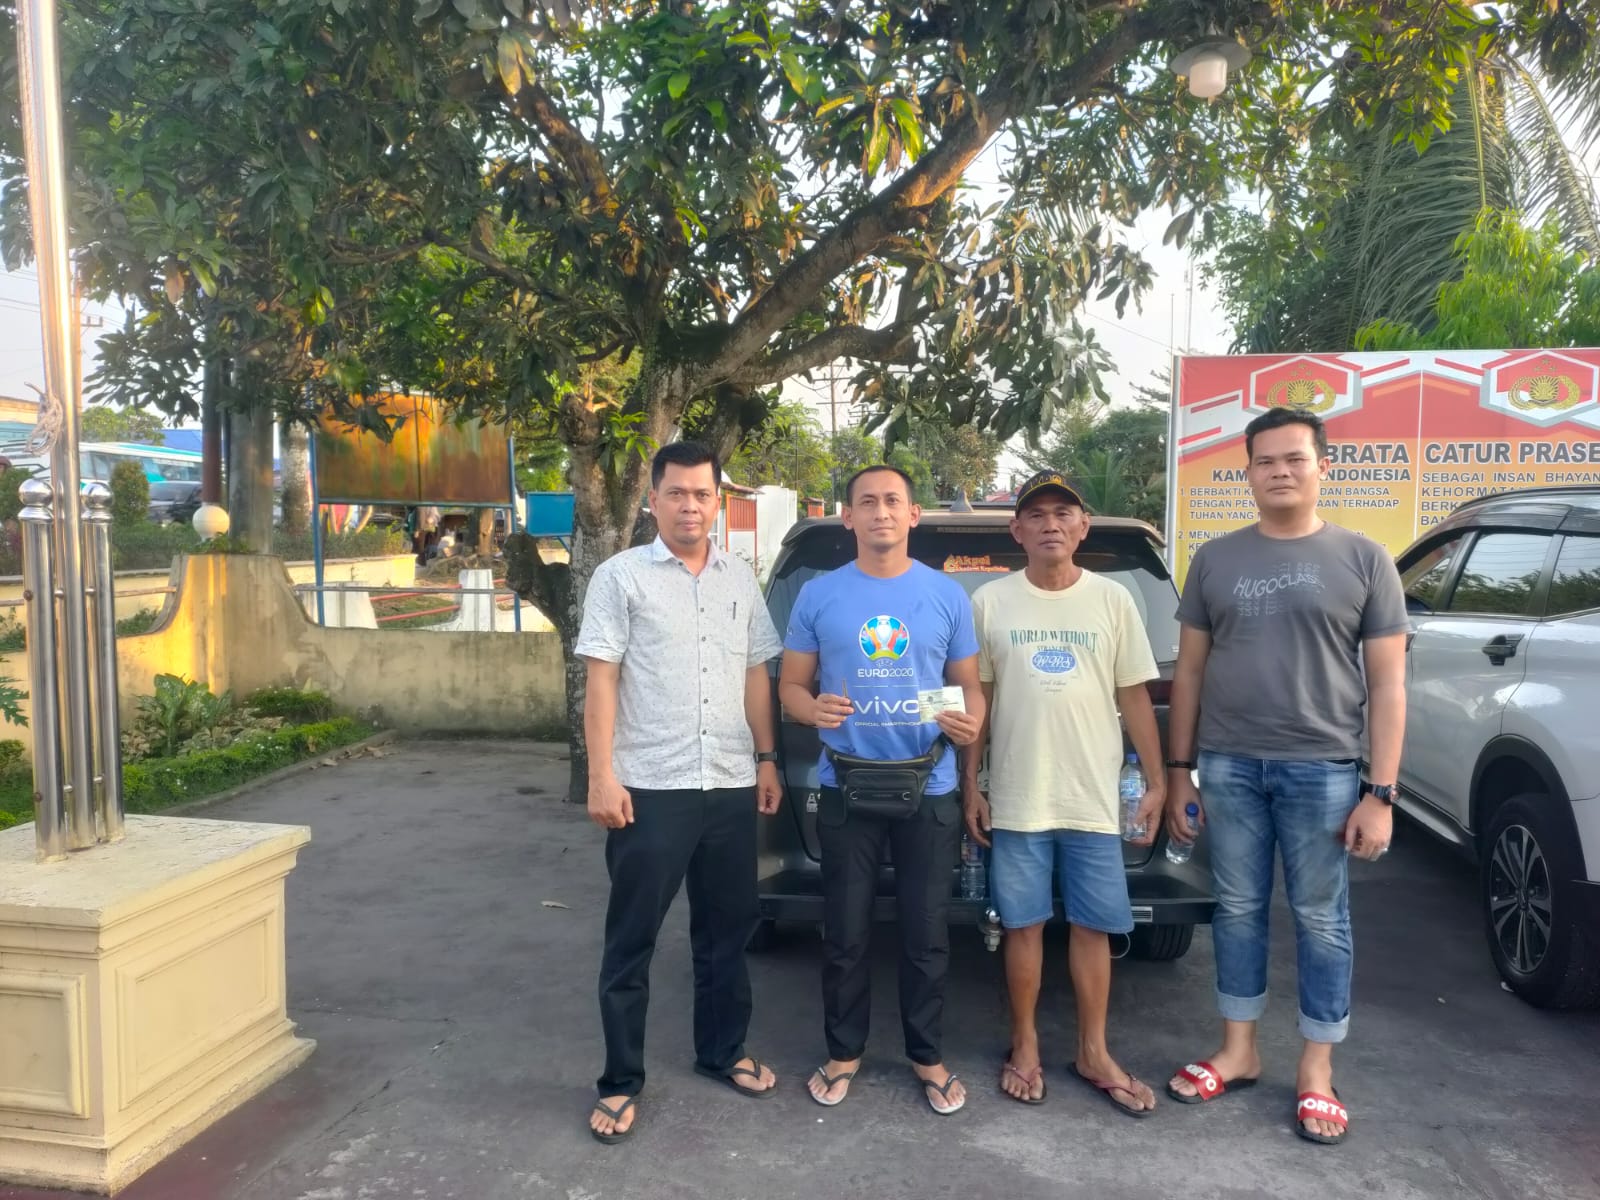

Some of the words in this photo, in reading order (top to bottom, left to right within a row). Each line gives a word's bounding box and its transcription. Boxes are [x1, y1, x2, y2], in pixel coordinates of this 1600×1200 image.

[1327, 444, 1410, 464] BRATA
[1425, 443, 1511, 464] CATUR
[1519, 442, 1600, 464] PRASE
[1213, 469, 1248, 482] KAM
[1321, 468, 1411, 482] NDONESIA
[1422, 472, 1484, 483] SEBAGAI
[1493, 472, 1536, 483] INSAN
[1545, 472, 1600, 482] BHAYAN
[1190, 487, 1241, 497] BERBAKTI
[1320, 487, 1342, 496] DAN
[1345, 487, 1390, 496] BANGSA
[1190, 499, 1232, 508] DENGAN
[1343, 499, 1400, 508] TERHADAP
[1190, 511, 1224, 520] TUHAN
[1227, 511, 1254, 520] YANG
[1010, 629, 1048, 648] WORLD
[1049, 630, 1098, 653] WITHOUT
